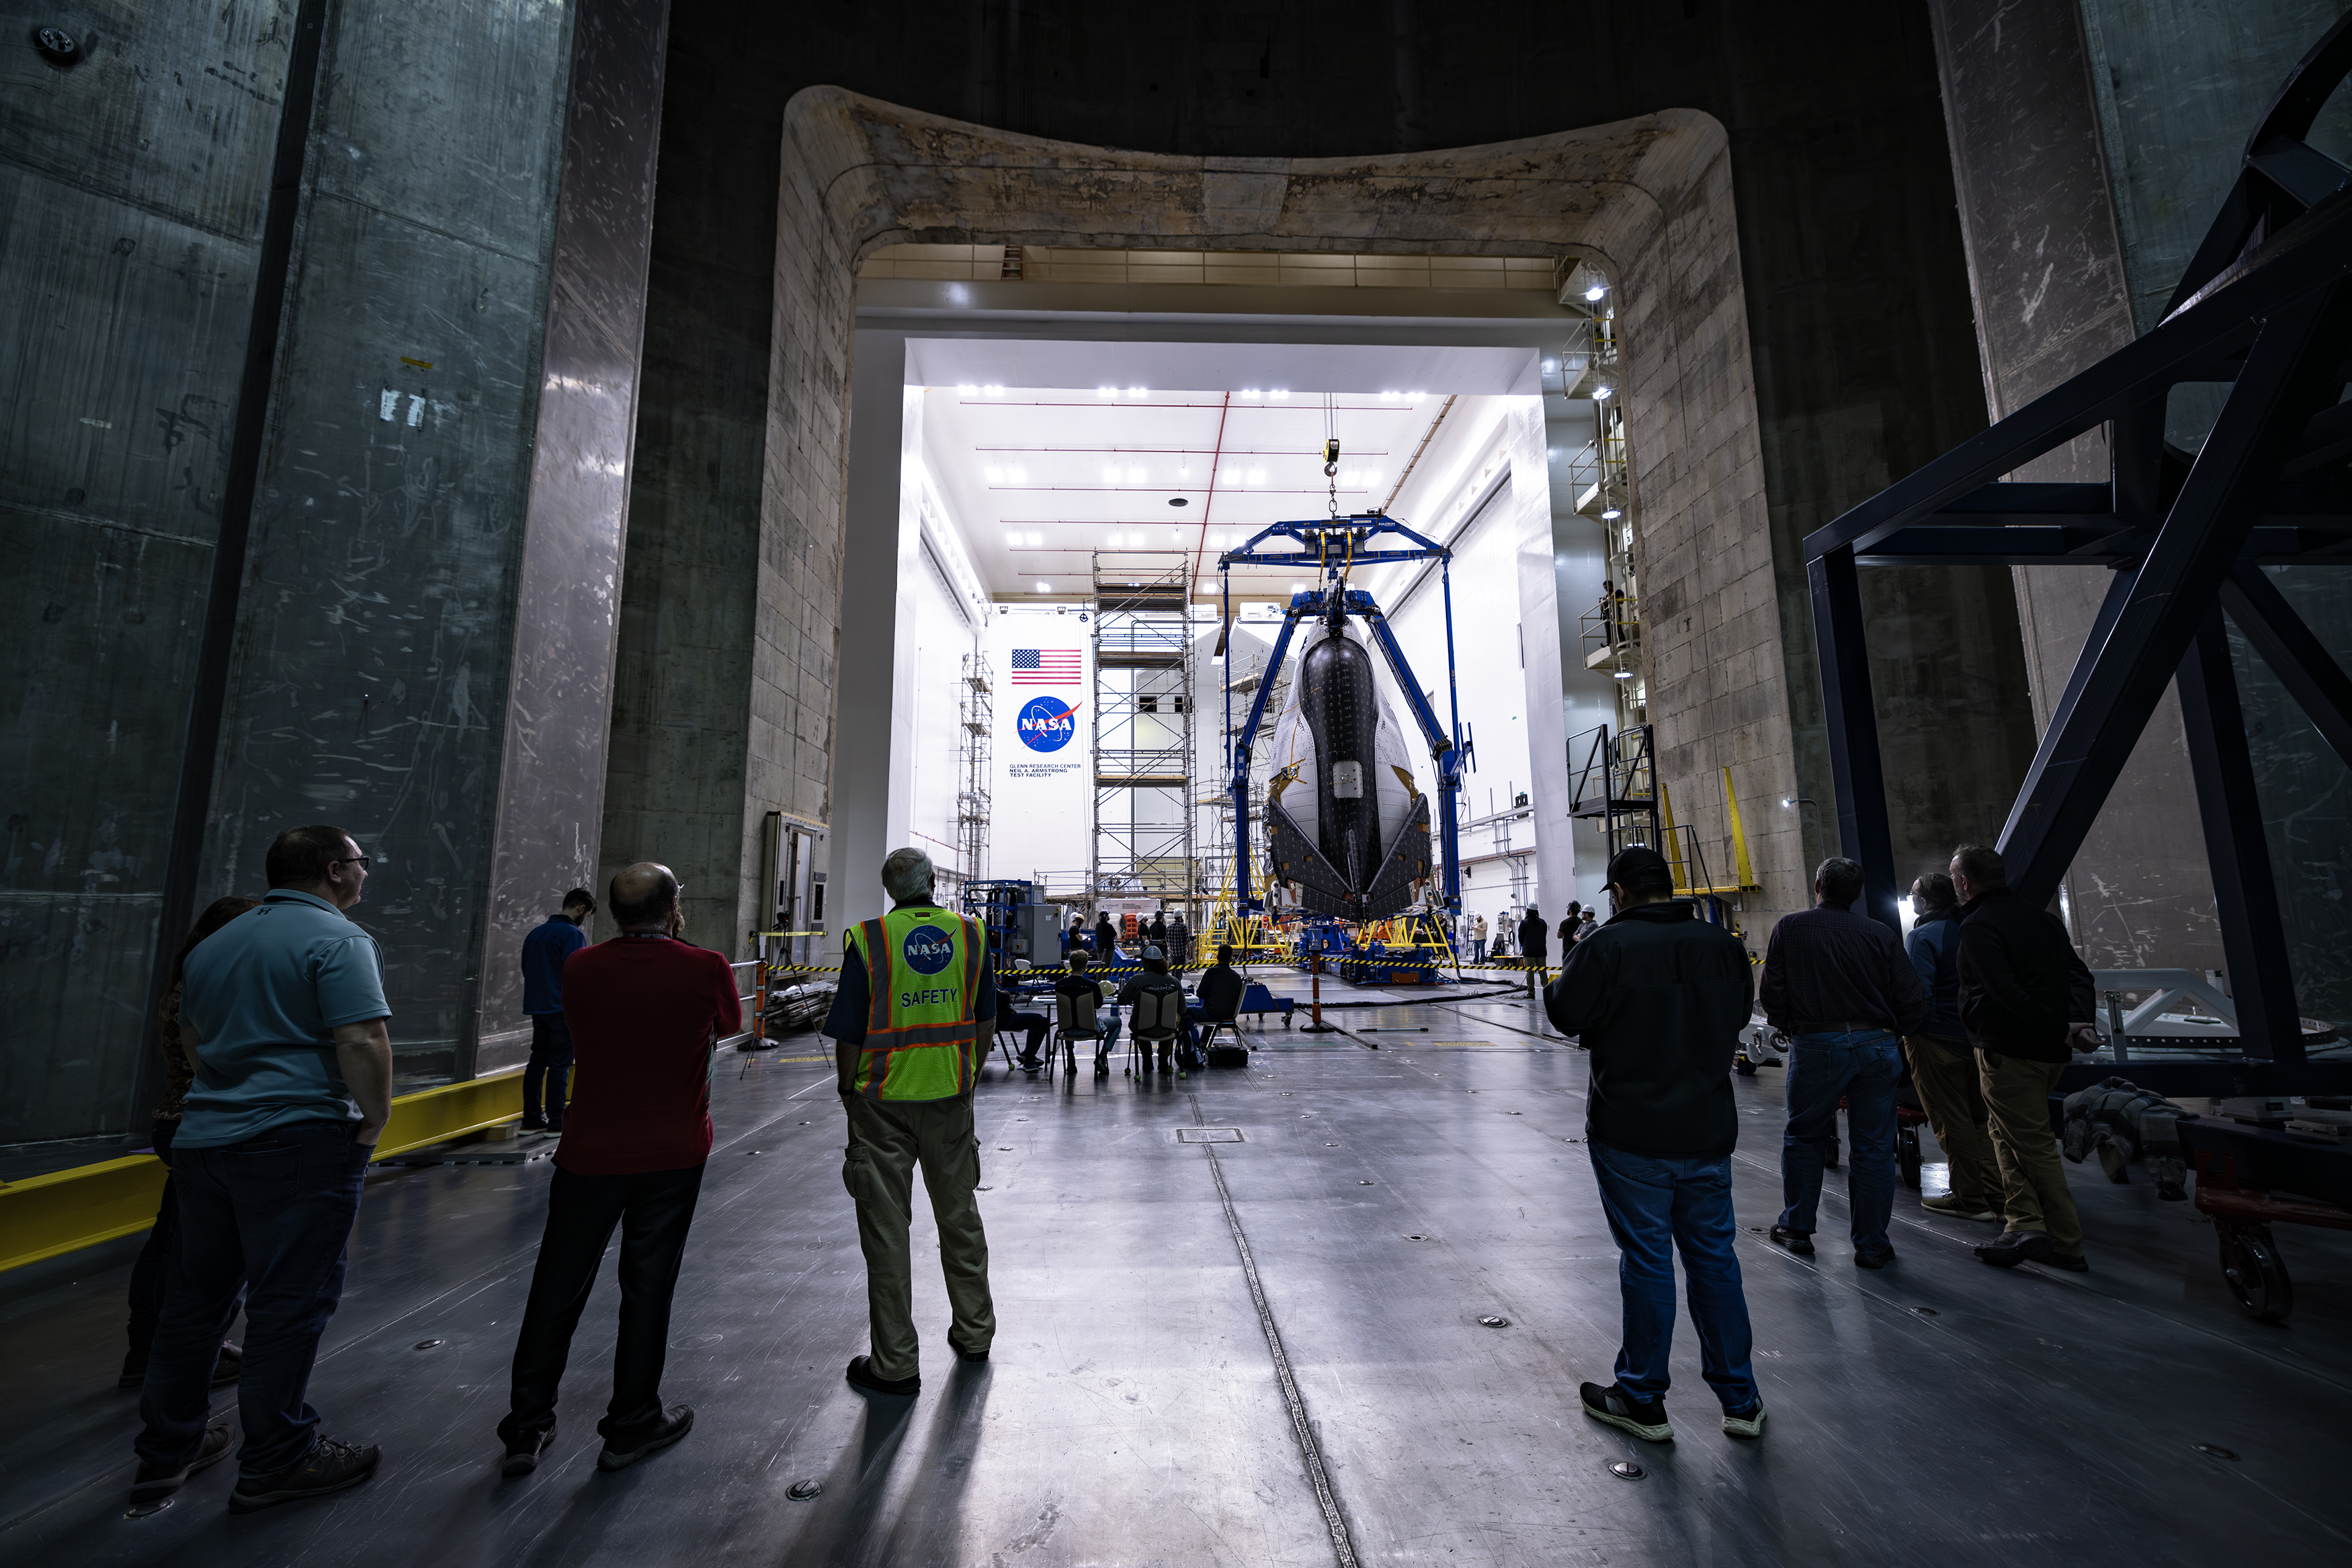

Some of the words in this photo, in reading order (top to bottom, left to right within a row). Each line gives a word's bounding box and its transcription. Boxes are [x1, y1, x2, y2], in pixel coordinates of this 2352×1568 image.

[1021, 718, 1072, 730] NASA
[907, 943, 952, 955] NASA
[901, 988, 958, 1008] SAFETY
